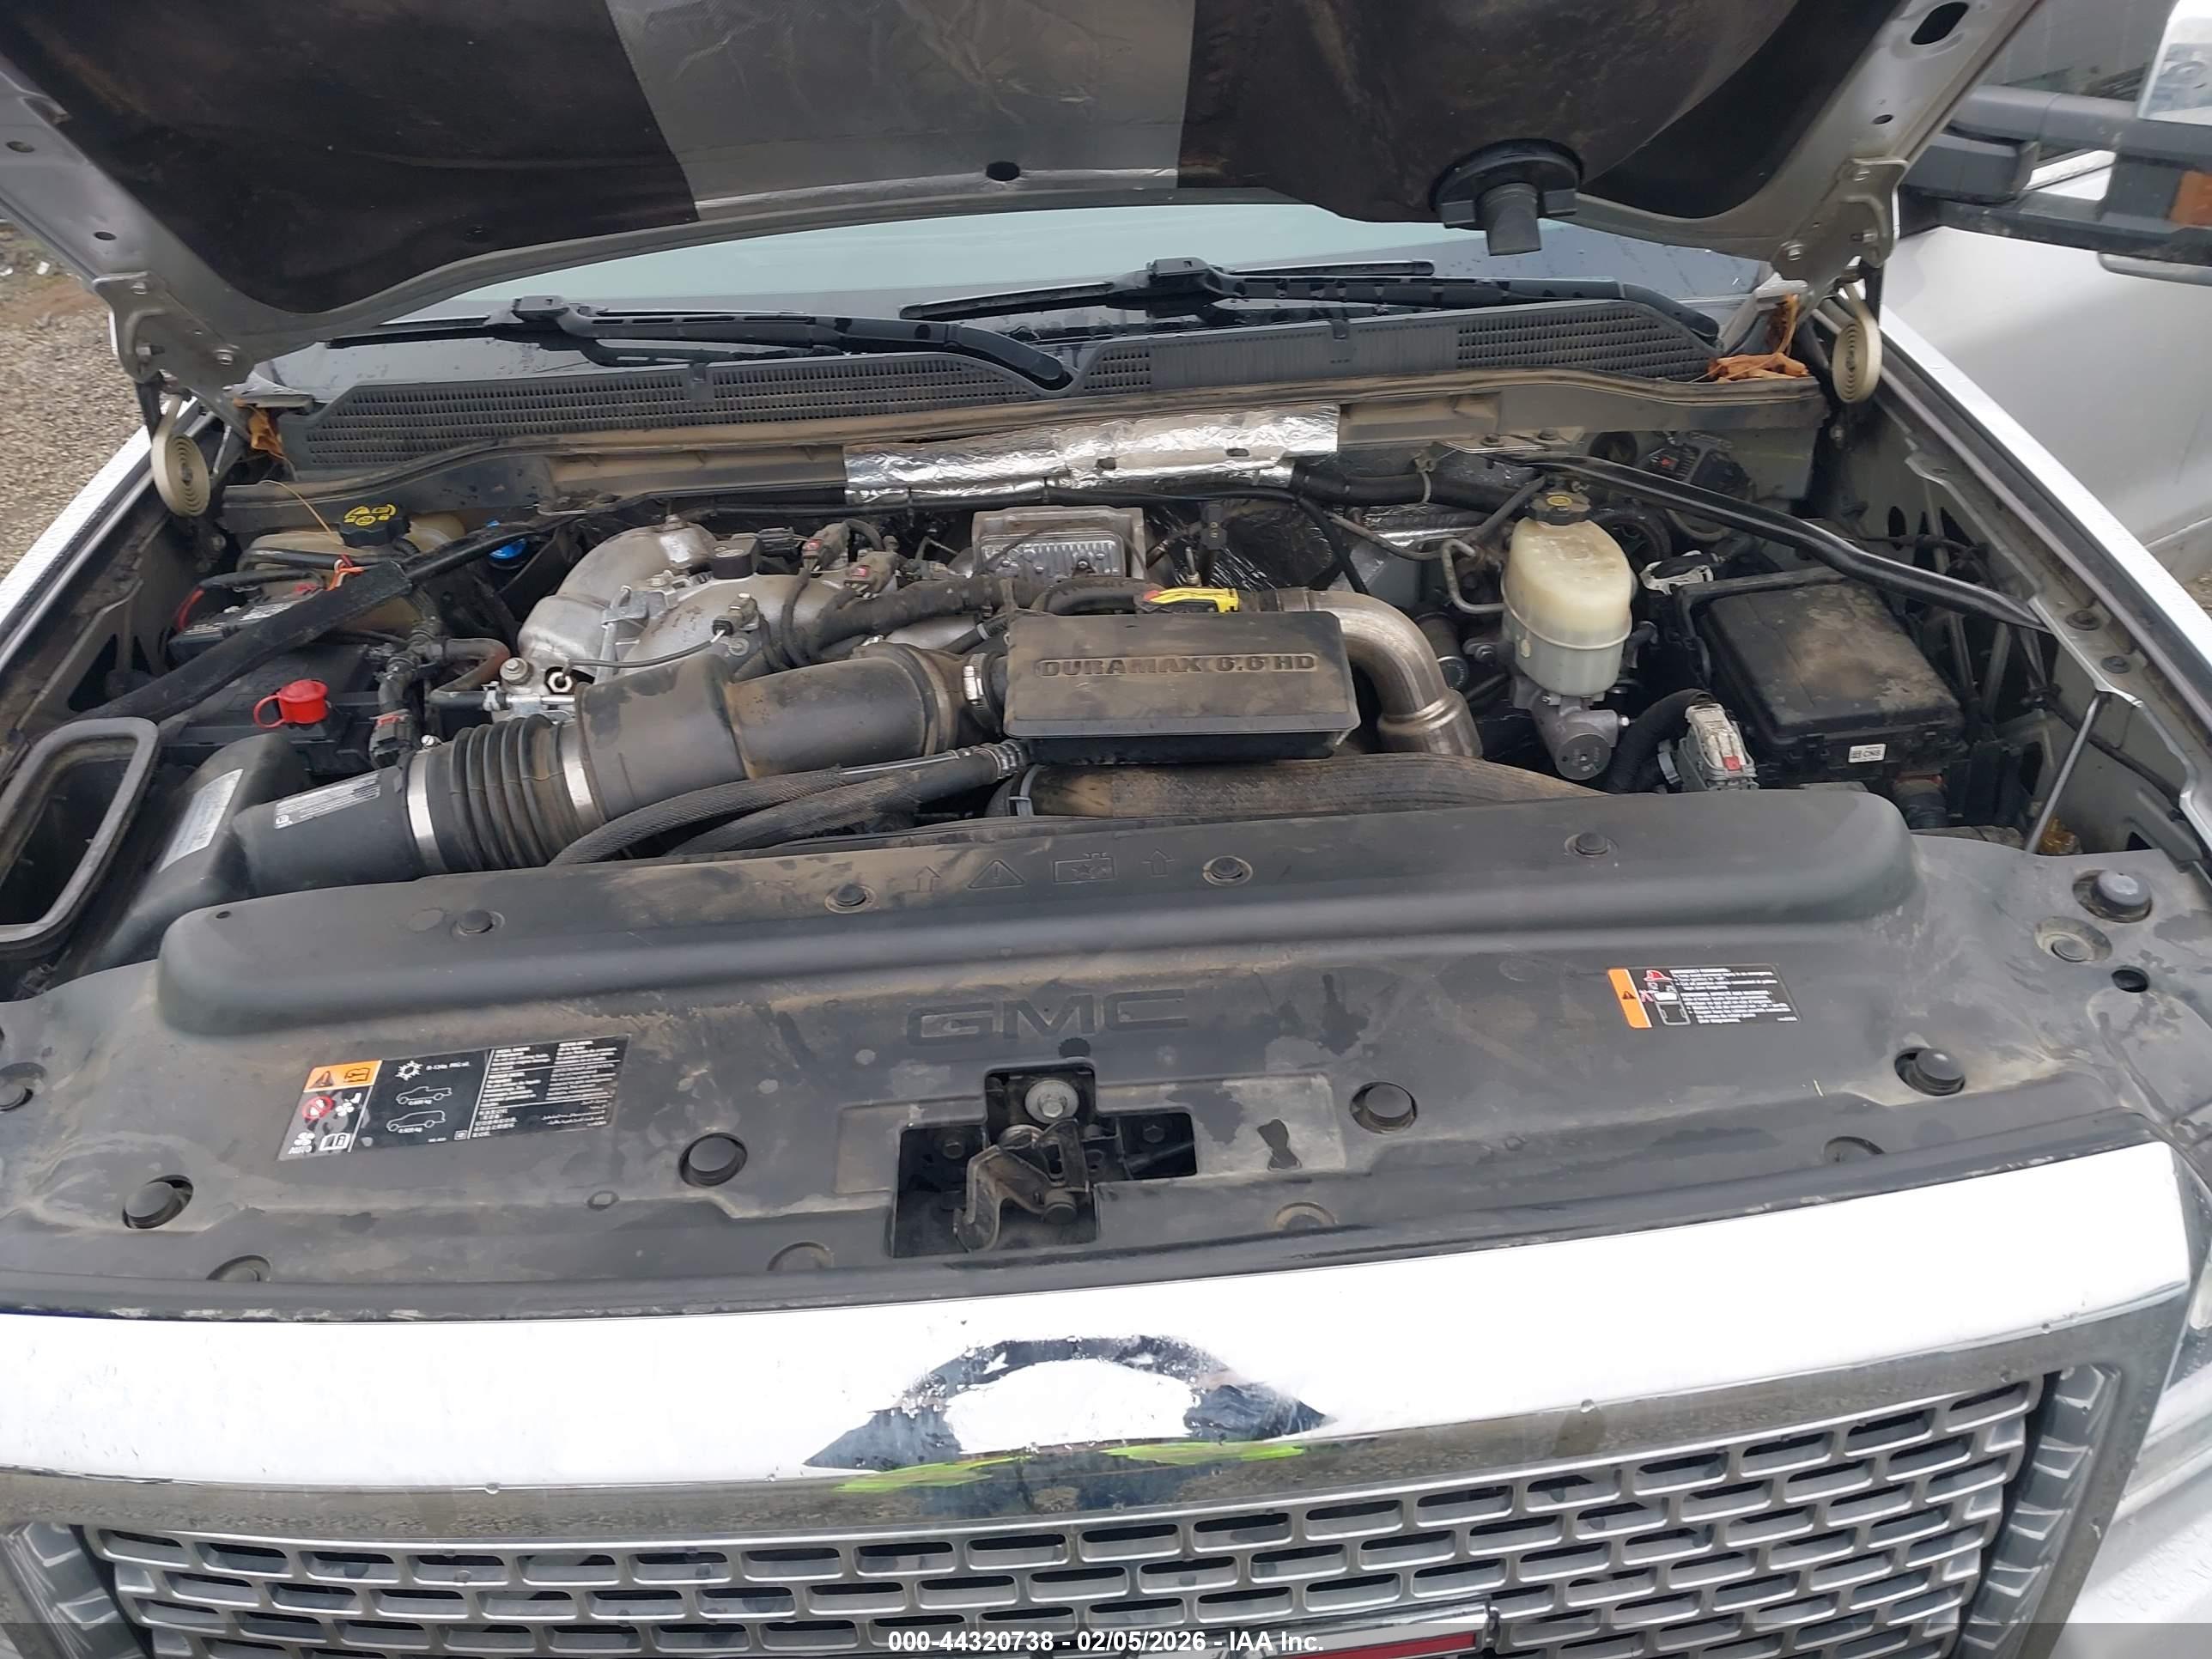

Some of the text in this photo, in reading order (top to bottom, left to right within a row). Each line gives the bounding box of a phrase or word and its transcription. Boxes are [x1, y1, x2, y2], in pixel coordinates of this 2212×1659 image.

[1041, 653, 1316, 677] DURAMAX 6.6 HD
[908, 988, 1188, 1046] GMC
